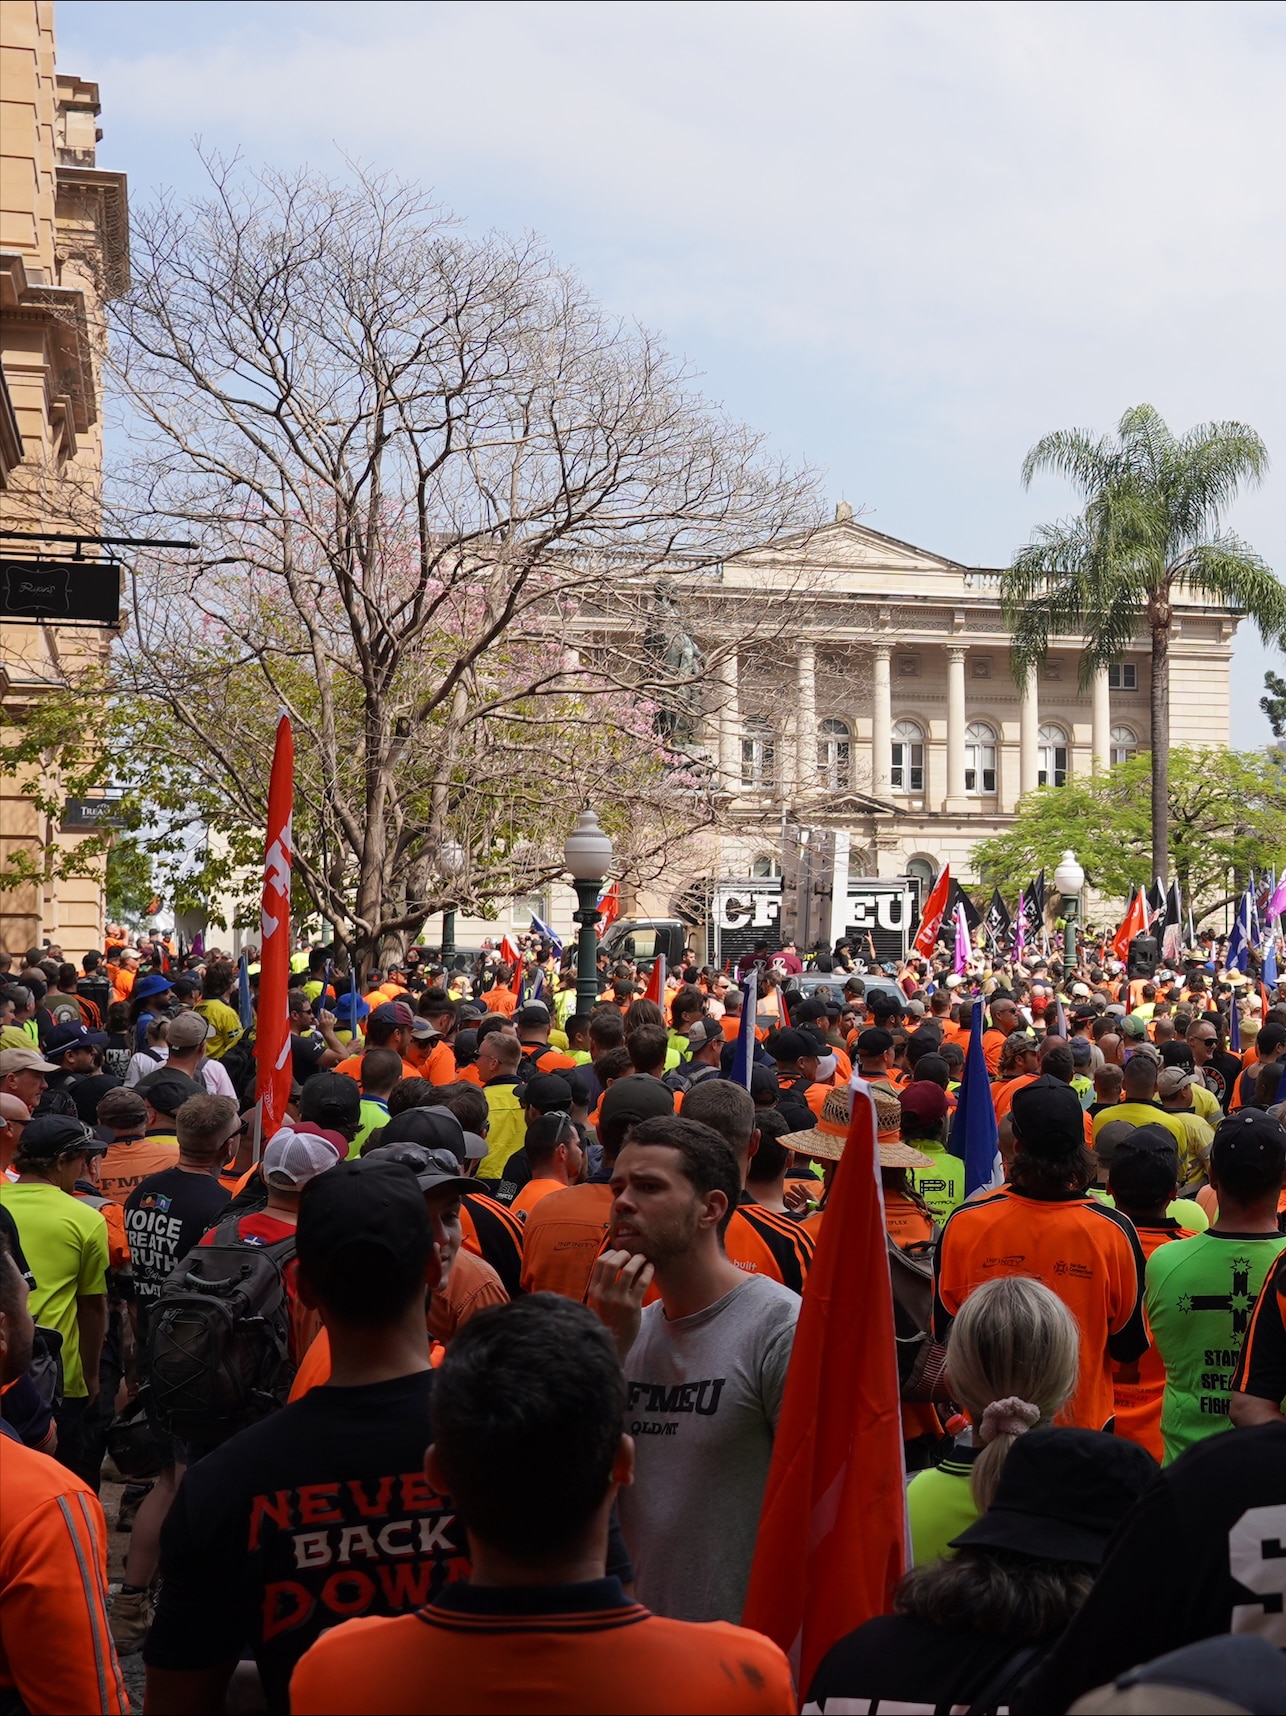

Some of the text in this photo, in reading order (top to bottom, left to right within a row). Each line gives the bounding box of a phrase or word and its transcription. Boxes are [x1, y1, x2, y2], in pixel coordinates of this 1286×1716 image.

[125, 1208, 183, 1240] VOICE
[126, 1230, 179, 1255] REATY
[130, 1246, 179, 1272] RUTH
[1204, 1350, 1240, 1367] STAN
[1202, 1374, 1233, 1392] SPE
[627, 1379, 726, 1416] FMEU
[1201, 1397, 1231, 1415] FIGH
[631, 1421, 680, 1436] QLD/NT
[247, 1472, 450, 1553] NEVE
[292, 1515, 458, 1569] BACK
